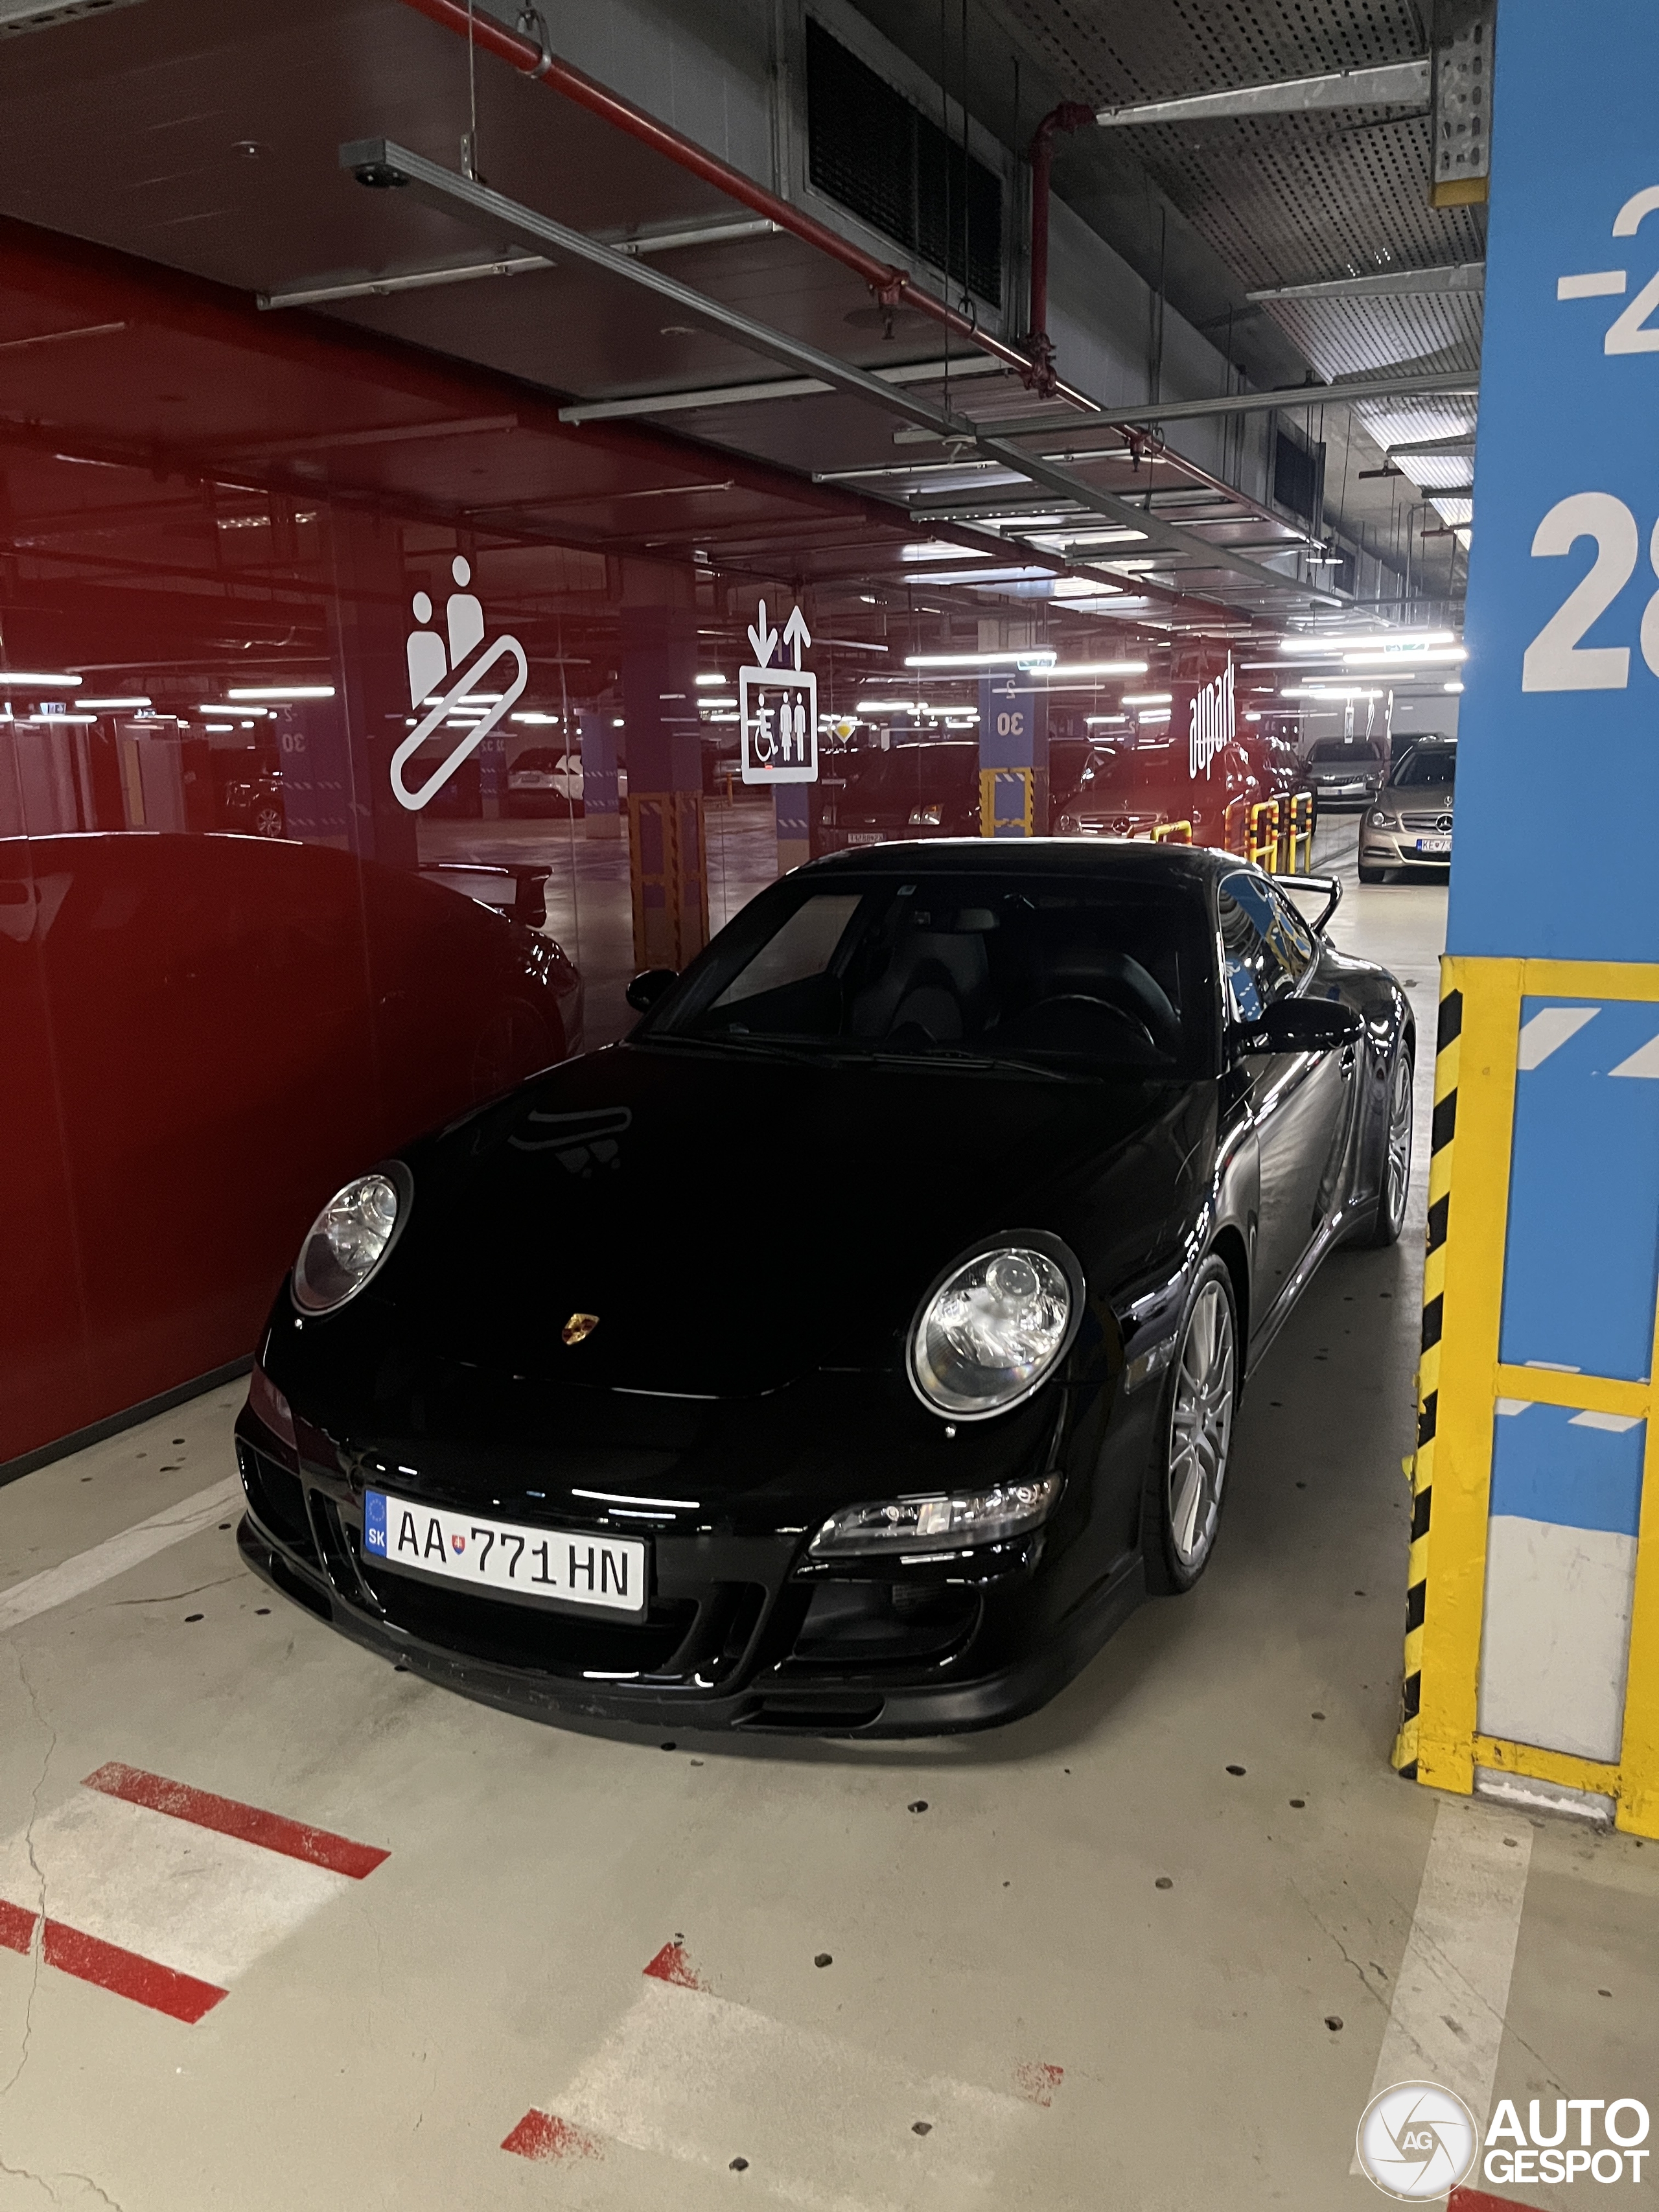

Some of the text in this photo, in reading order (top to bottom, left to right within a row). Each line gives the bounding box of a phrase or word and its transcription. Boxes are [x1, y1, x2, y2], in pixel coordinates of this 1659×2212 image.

[1522, 492, 1659, 692] 2
[1190, 649, 1235, 781] aupark
[368, 1528, 386, 1547] SK
[397, 1511, 447, 1564] AA
